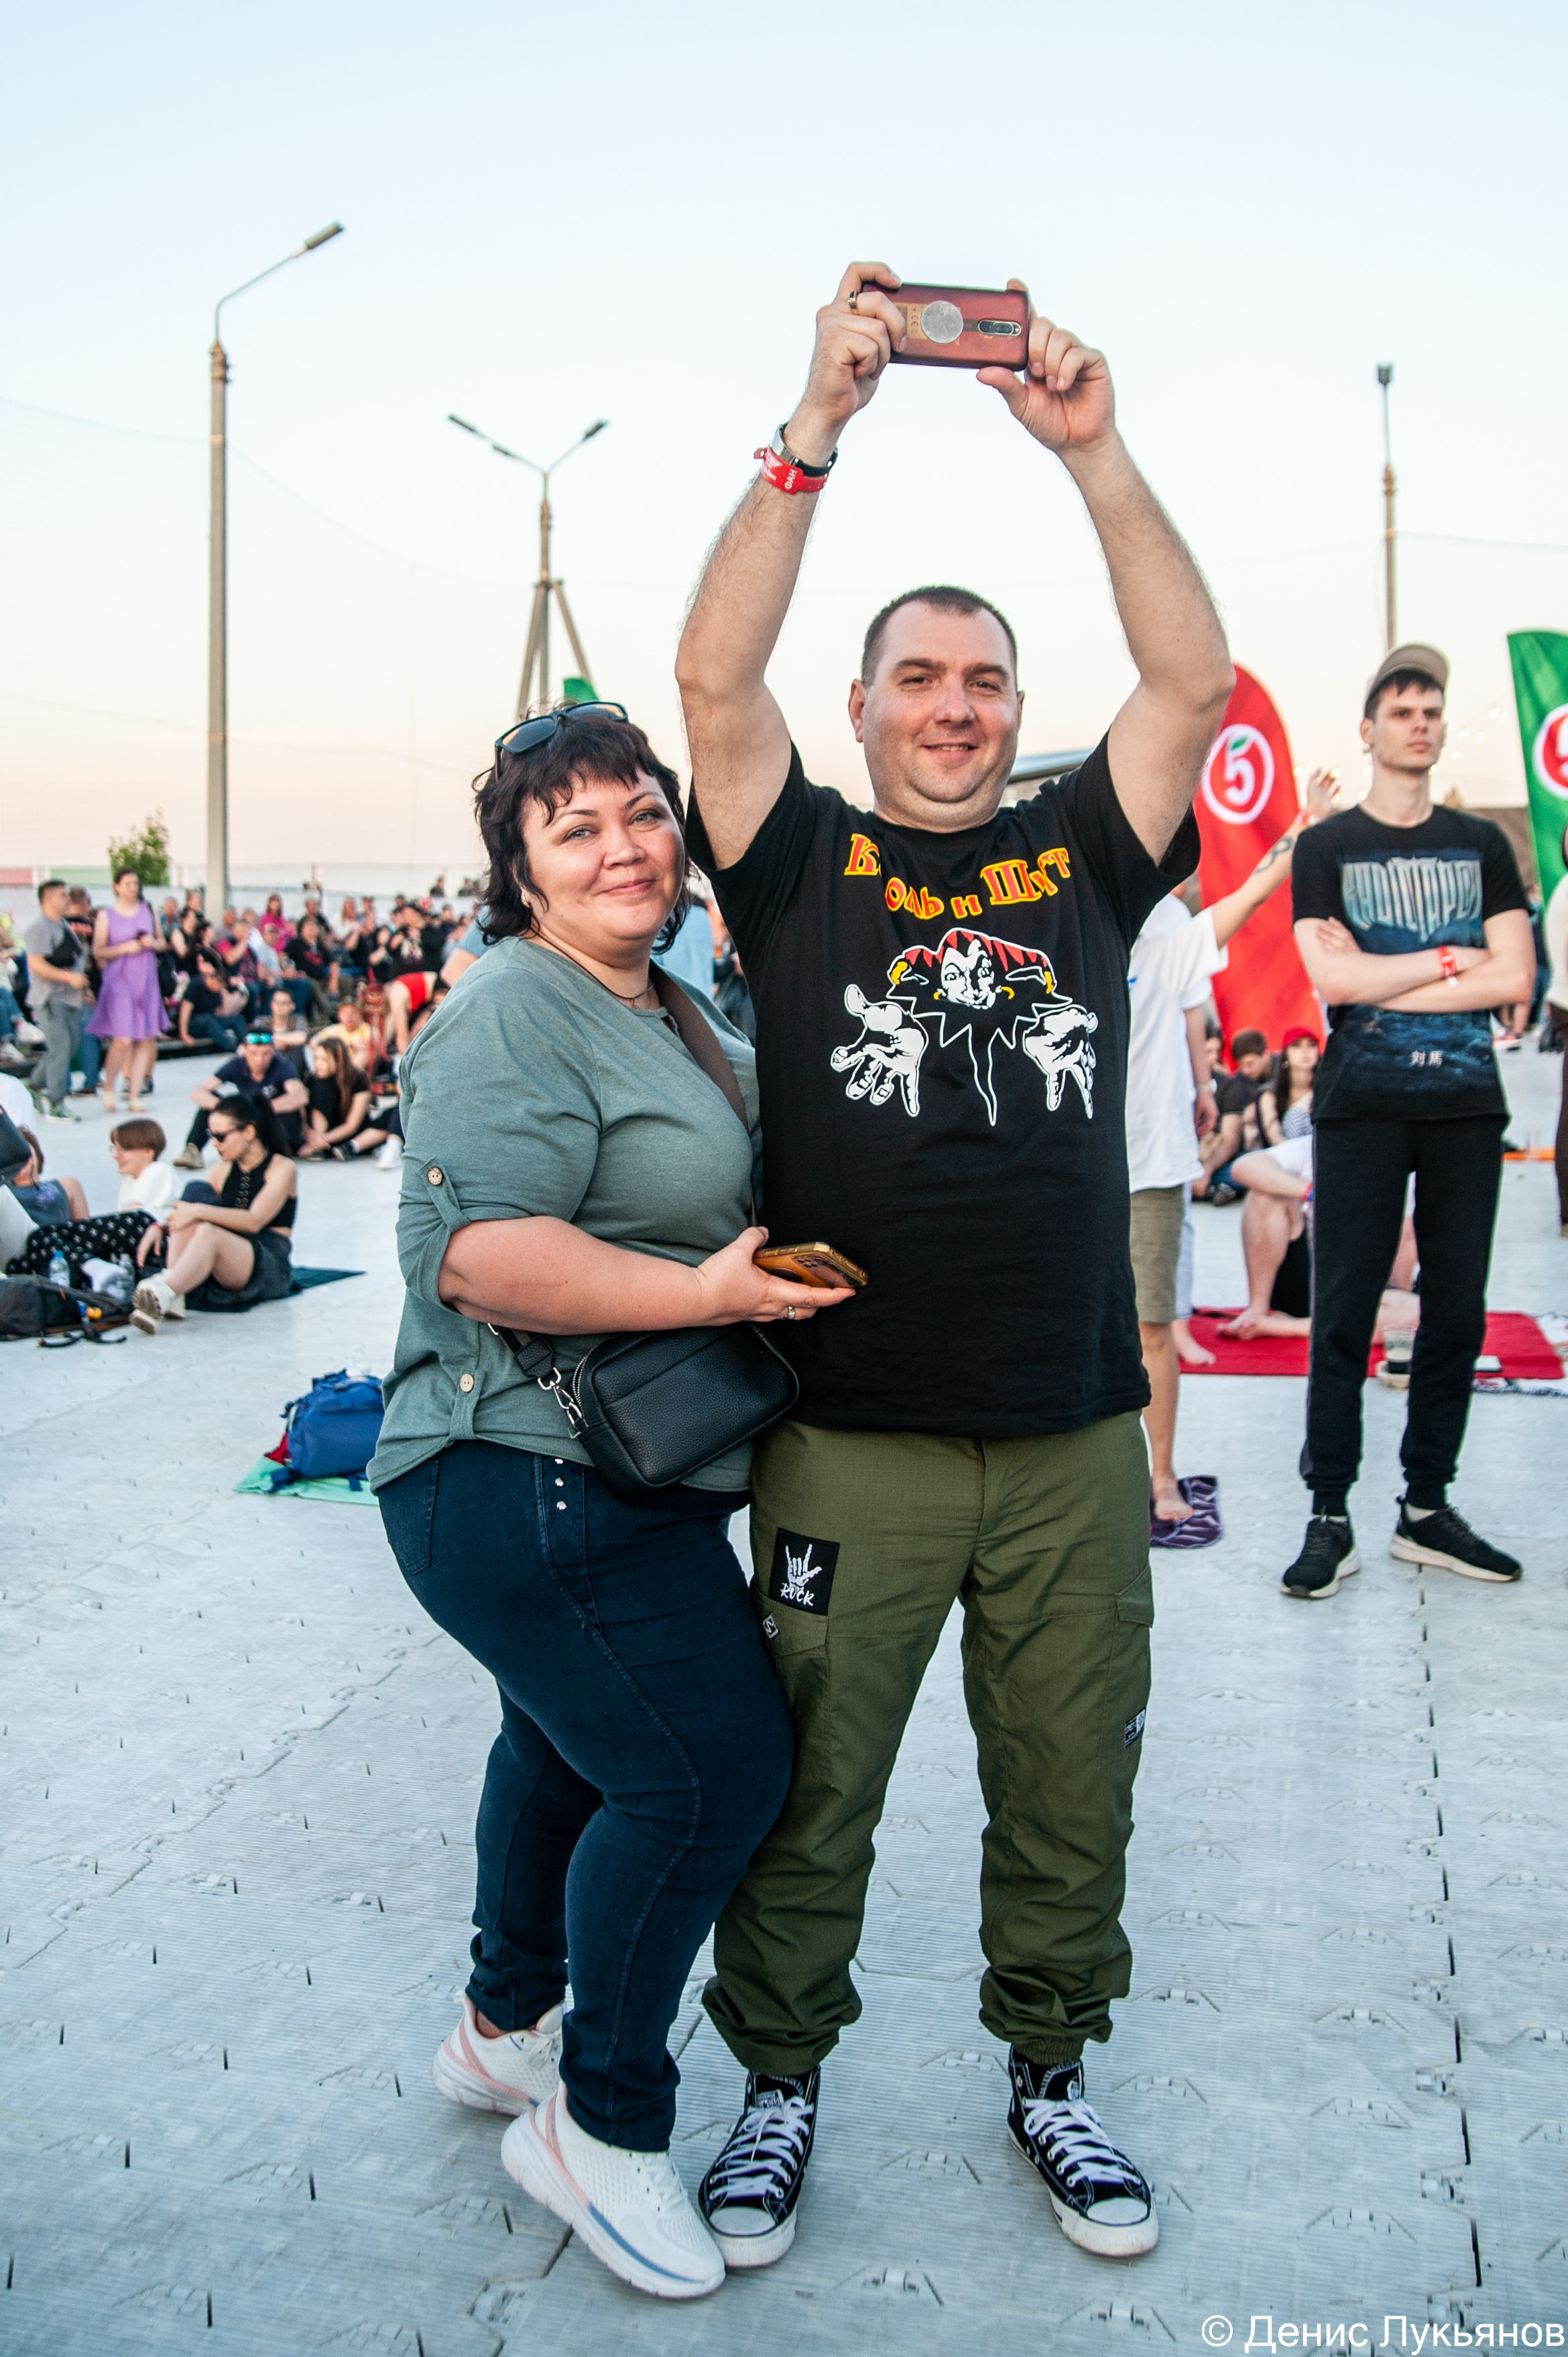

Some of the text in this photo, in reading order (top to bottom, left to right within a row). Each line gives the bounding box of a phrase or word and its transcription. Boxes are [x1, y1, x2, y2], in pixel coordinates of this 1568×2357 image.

[784, 469, 798, 490] ФАН
[1225, 736, 1256, 806] 5
[780, 1583, 814, 1606] ROCK
